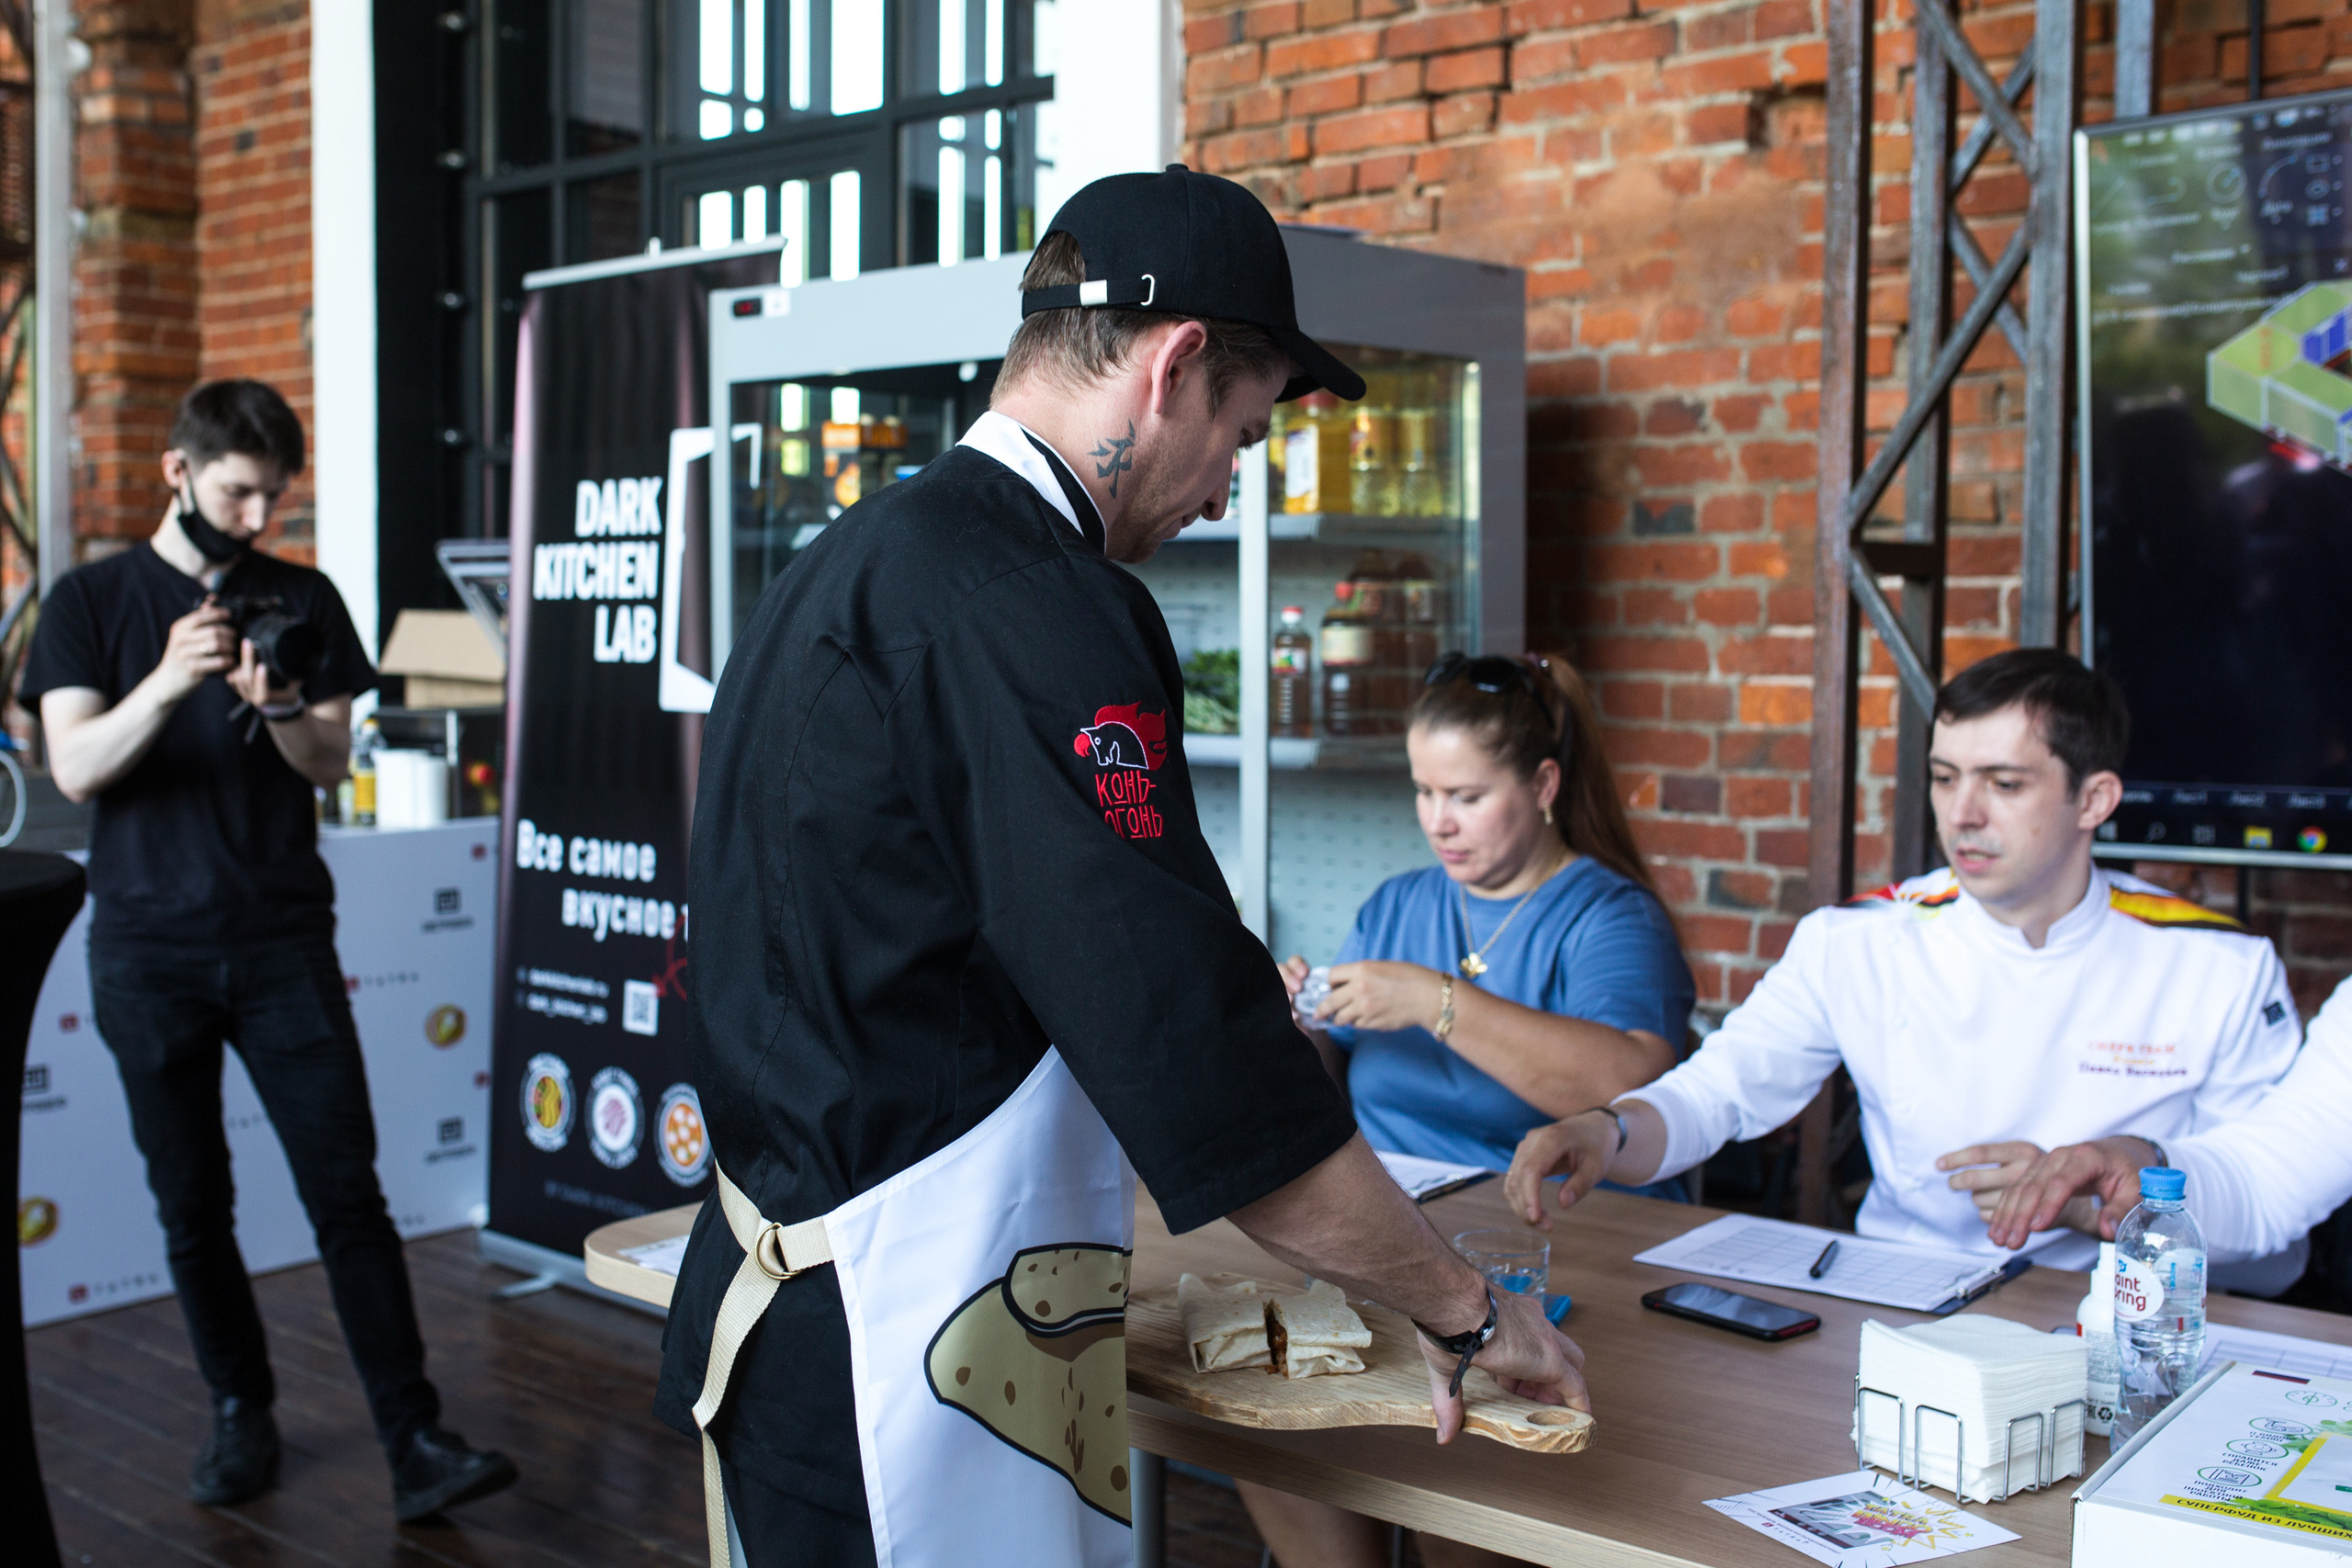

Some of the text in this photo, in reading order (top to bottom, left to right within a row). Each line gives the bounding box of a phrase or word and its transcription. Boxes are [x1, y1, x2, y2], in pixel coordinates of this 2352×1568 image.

[575, 476, 662, 537] DARK
[533, 541, 659, 600] KITCHEN
[594, 604, 657, 662] LAB
[516, 819, 656, 883] Все самое
[561, 887, 676, 942] вкусное
[2115, 1274, 2141, 1292] aint
[2177, 1498, 2352, 1539] СУПЕРФУД ИЗ ЛУЧШИХ
